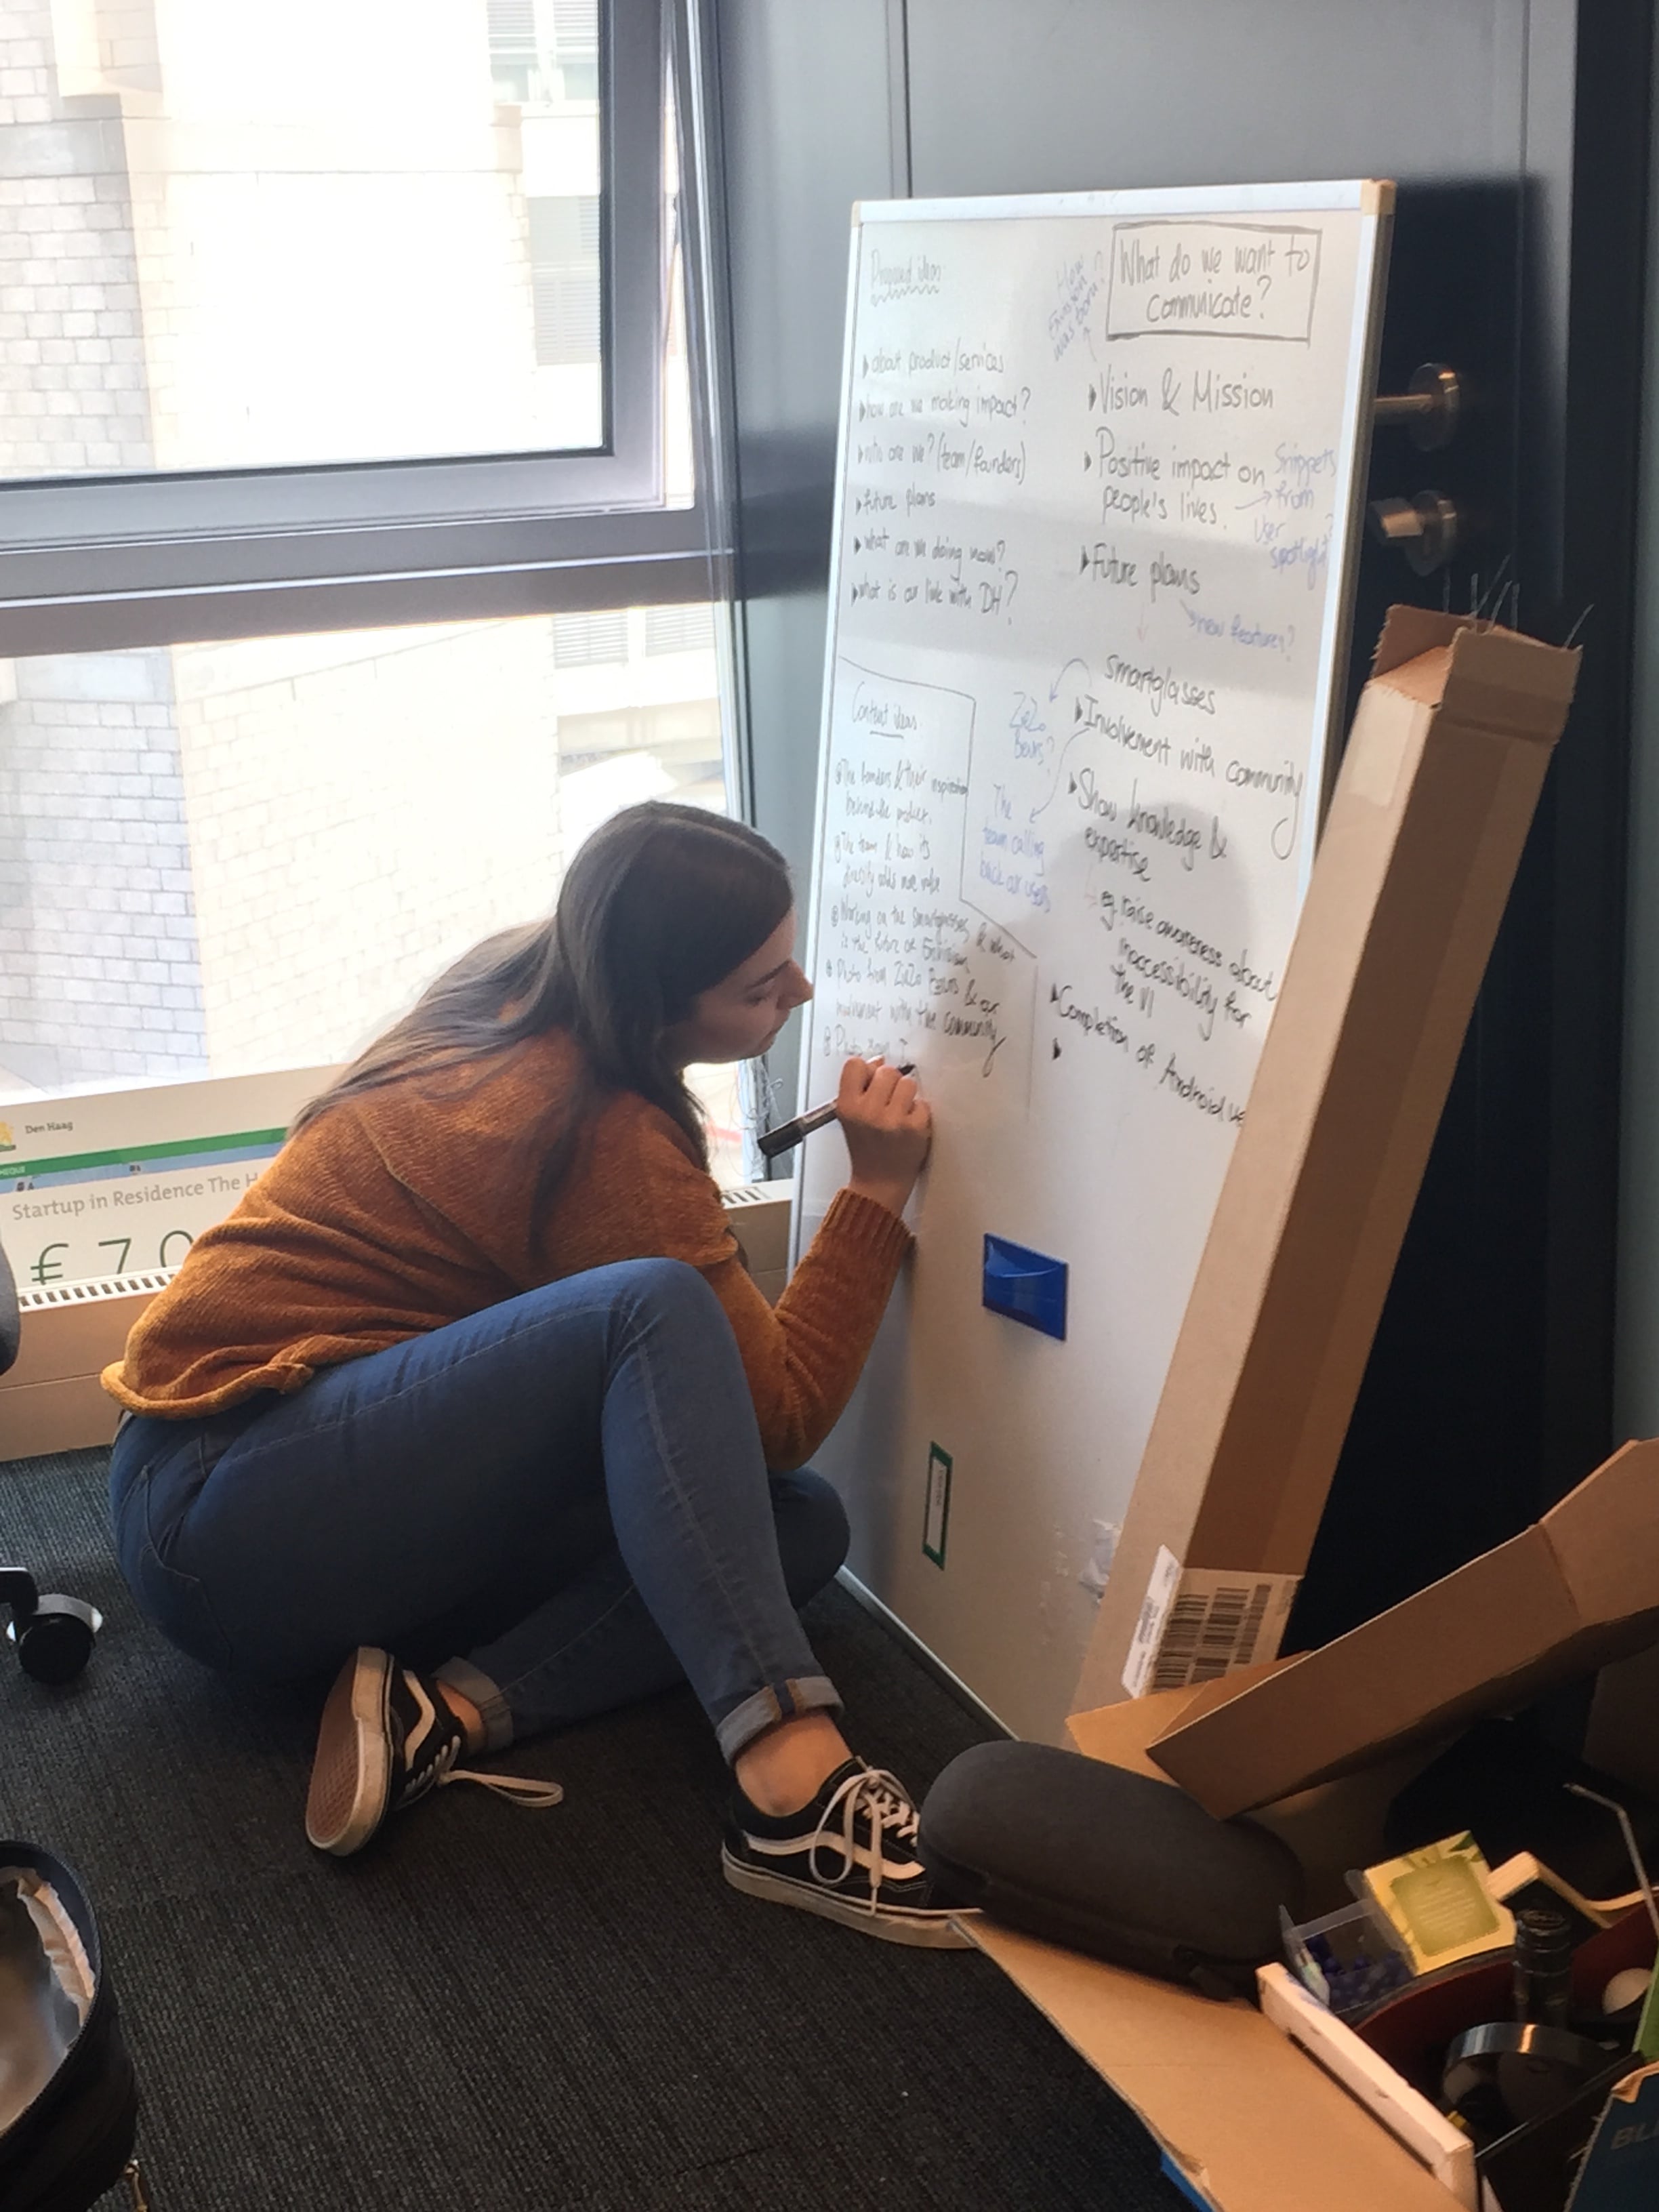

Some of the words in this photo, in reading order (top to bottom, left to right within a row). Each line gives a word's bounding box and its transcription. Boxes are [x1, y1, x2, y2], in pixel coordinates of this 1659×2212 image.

[1120, 239, 1160, 285] What
[1169, 243, 1191, 282] do
[1202, 246, 1222, 274] we
[1235, 239, 1275, 276] want
[1285, 234, 1310, 276] to
[1100, 364, 1148, 413] Vision
[1162, 367, 1182, 416] &
[1193, 370, 1273, 413] Mission
[1096, 426, 1160, 480] Positive
[1172, 445, 1231, 489] impact
[1237, 466, 1265, 485] on
[1092, 543, 1139, 587] Future
[1150, 551, 1200, 603] plans
[1180, 737, 1215, 777] with
[1078, 768, 1117, 821] Show
[25, 1124, 45, 1134] Den
[47, 1122, 73, 1132] Haag
[12, 1197, 85, 1221] Startup
[90, 1194, 108, 1210] in
[114, 1182, 204, 1206] Residence
[207, 1176, 241, 1194] The
[246, 1173, 259, 1188] H
